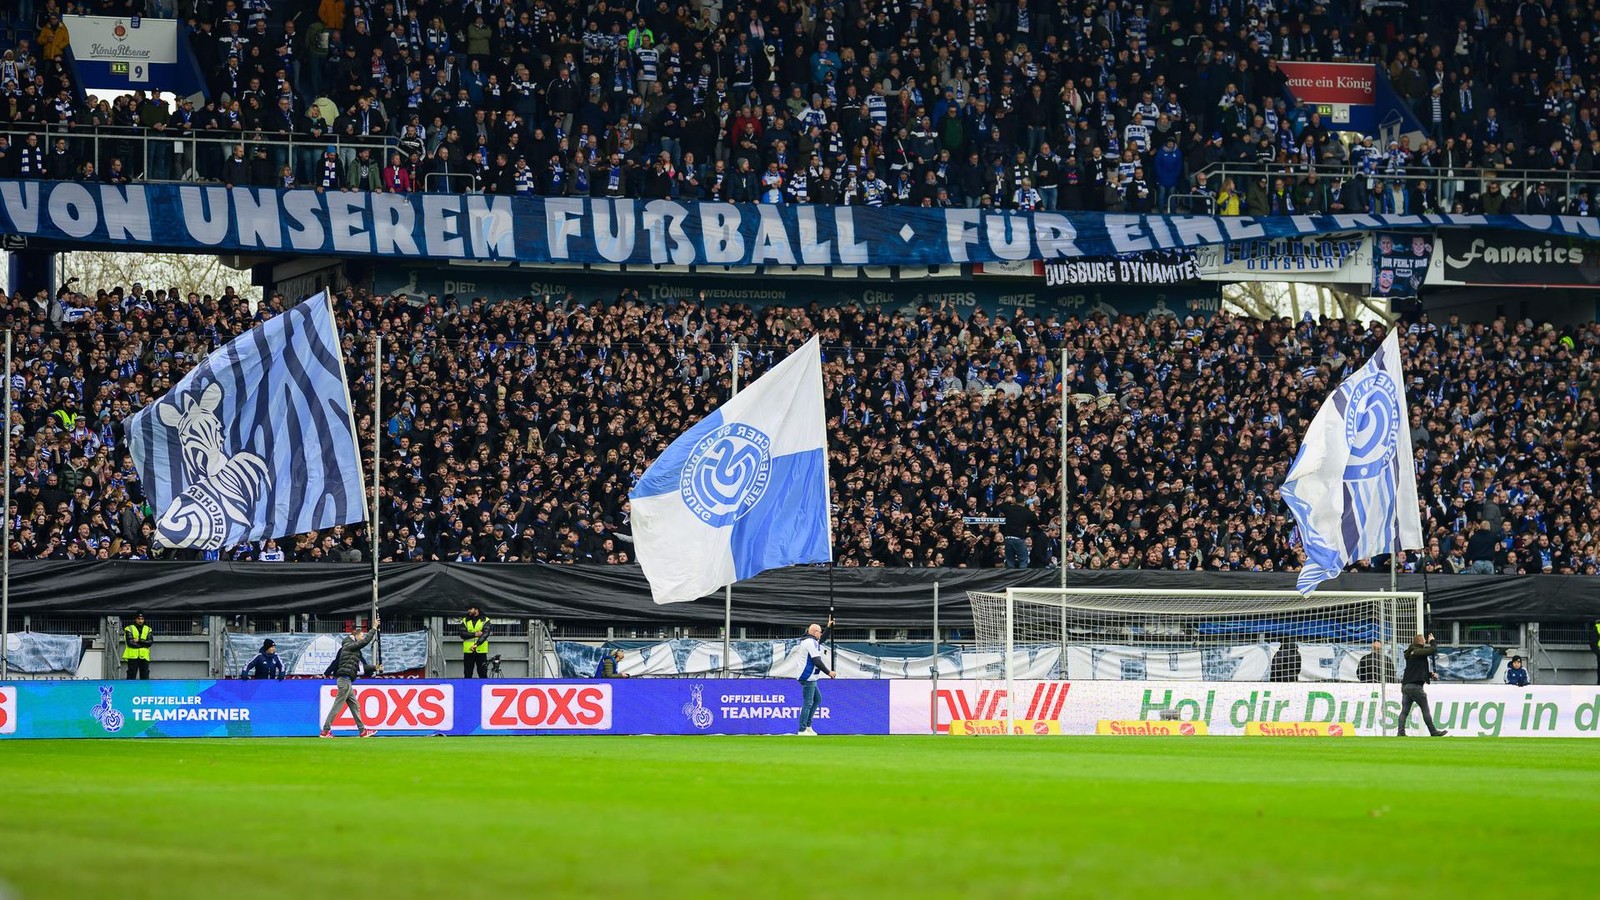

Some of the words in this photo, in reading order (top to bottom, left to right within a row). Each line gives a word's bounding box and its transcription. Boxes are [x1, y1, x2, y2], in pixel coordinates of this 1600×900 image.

[134, 65, 143, 79] 9
[1285, 74, 1313, 88] eute
[1315, 76, 1333, 88] ein
[1336, 76, 1372, 94] König
[1, 181, 152, 242] VON
[180, 185, 517, 258] UNSEREM
[944, 207, 1085, 262] FÜR
[1446, 238, 1584, 269] Fanatics
[1393, 257, 1413, 268] FEHLT
[1044, 260, 1116, 287] DUISBURG
[1119, 258, 1202, 284] DYNAMITES
[444, 279, 476, 294] DIETZ
[531, 282, 566, 297] SALOU
[132, 696, 202, 705] OFFIZIELLER
[490, 687, 604, 726] ZOXS
[720, 694, 785, 704] OFFIZIELLER
[132, 708, 250, 721] TEAMPARTNER
[720, 706, 830, 719] TEAMPARTER
[1139, 689, 1215, 727] Hol
[1230, 690, 1289, 728] dir
[1519, 693, 1559, 731] in
[964, 720, 1024, 735] Sinalo
[1110, 720, 1170, 736] Sinalco
[1259, 722, 1319, 736] Sinalco
